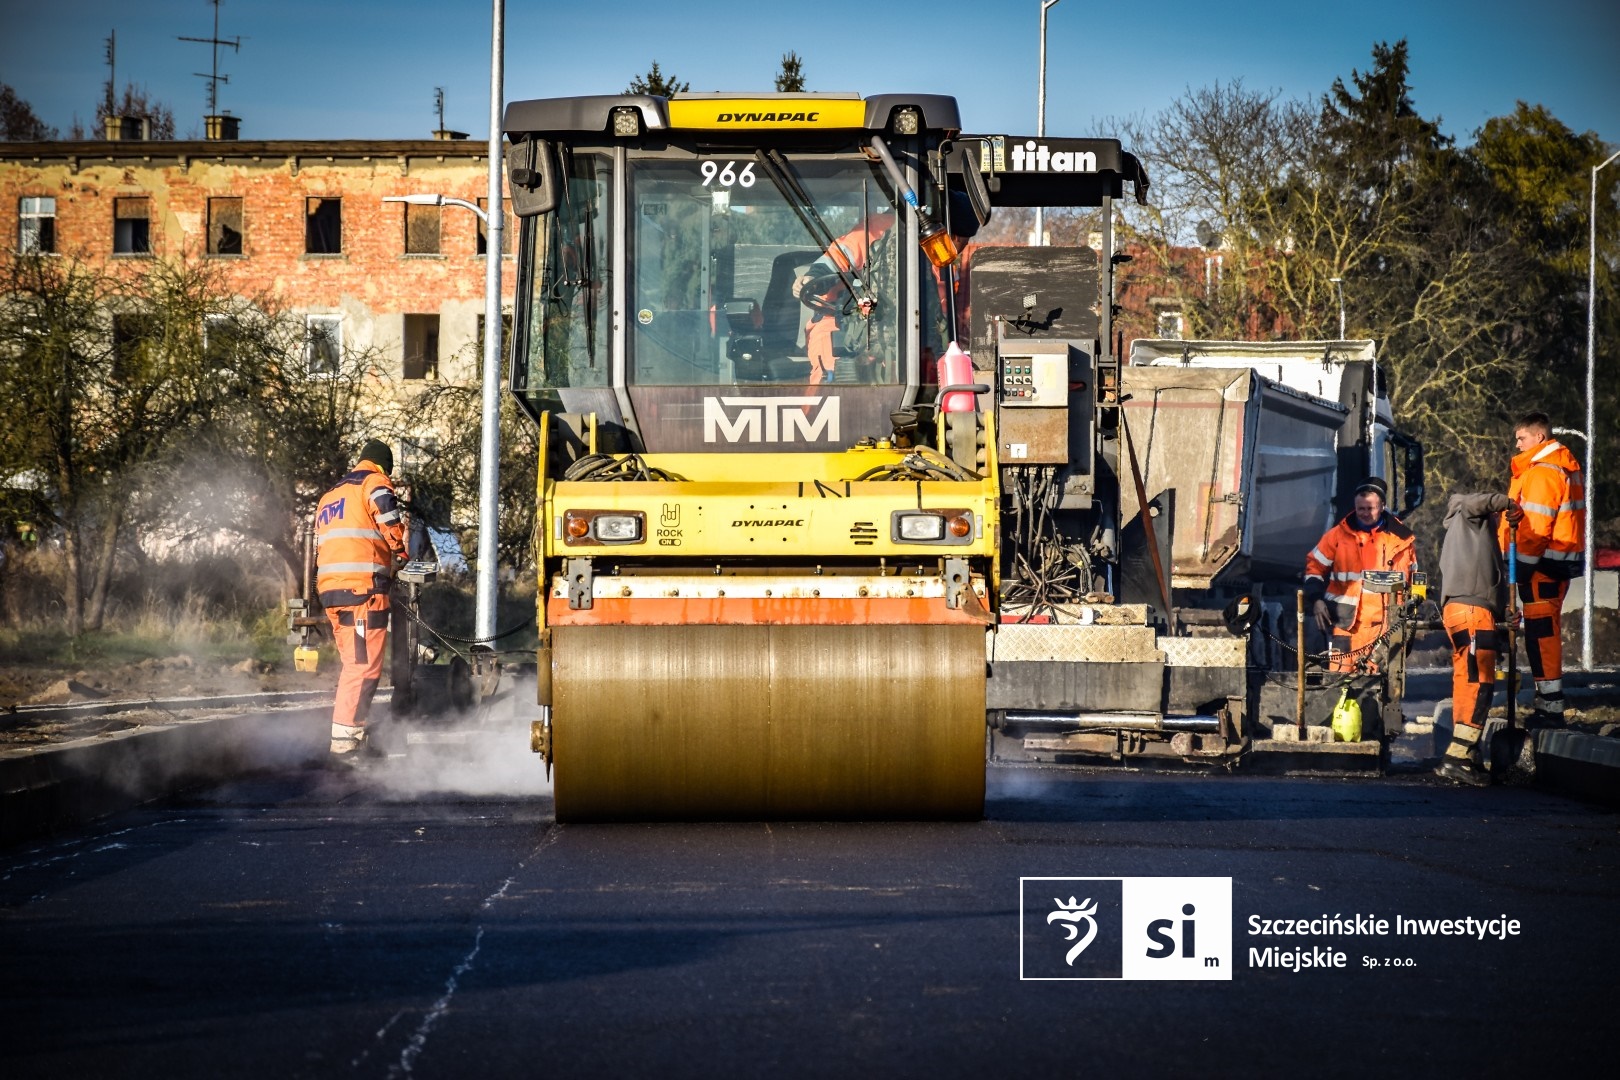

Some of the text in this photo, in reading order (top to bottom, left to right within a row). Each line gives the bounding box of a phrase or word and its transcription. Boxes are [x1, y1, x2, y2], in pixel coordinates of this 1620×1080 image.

[717, 112, 820, 122] DYNAPAC
[1011, 141, 1097, 172] titan
[700, 160, 757, 188] 966
[703, 396, 841, 442] MTM
[731, 519, 805, 527] DYNAPAC
[656, 529, 683, 537] ROCK
